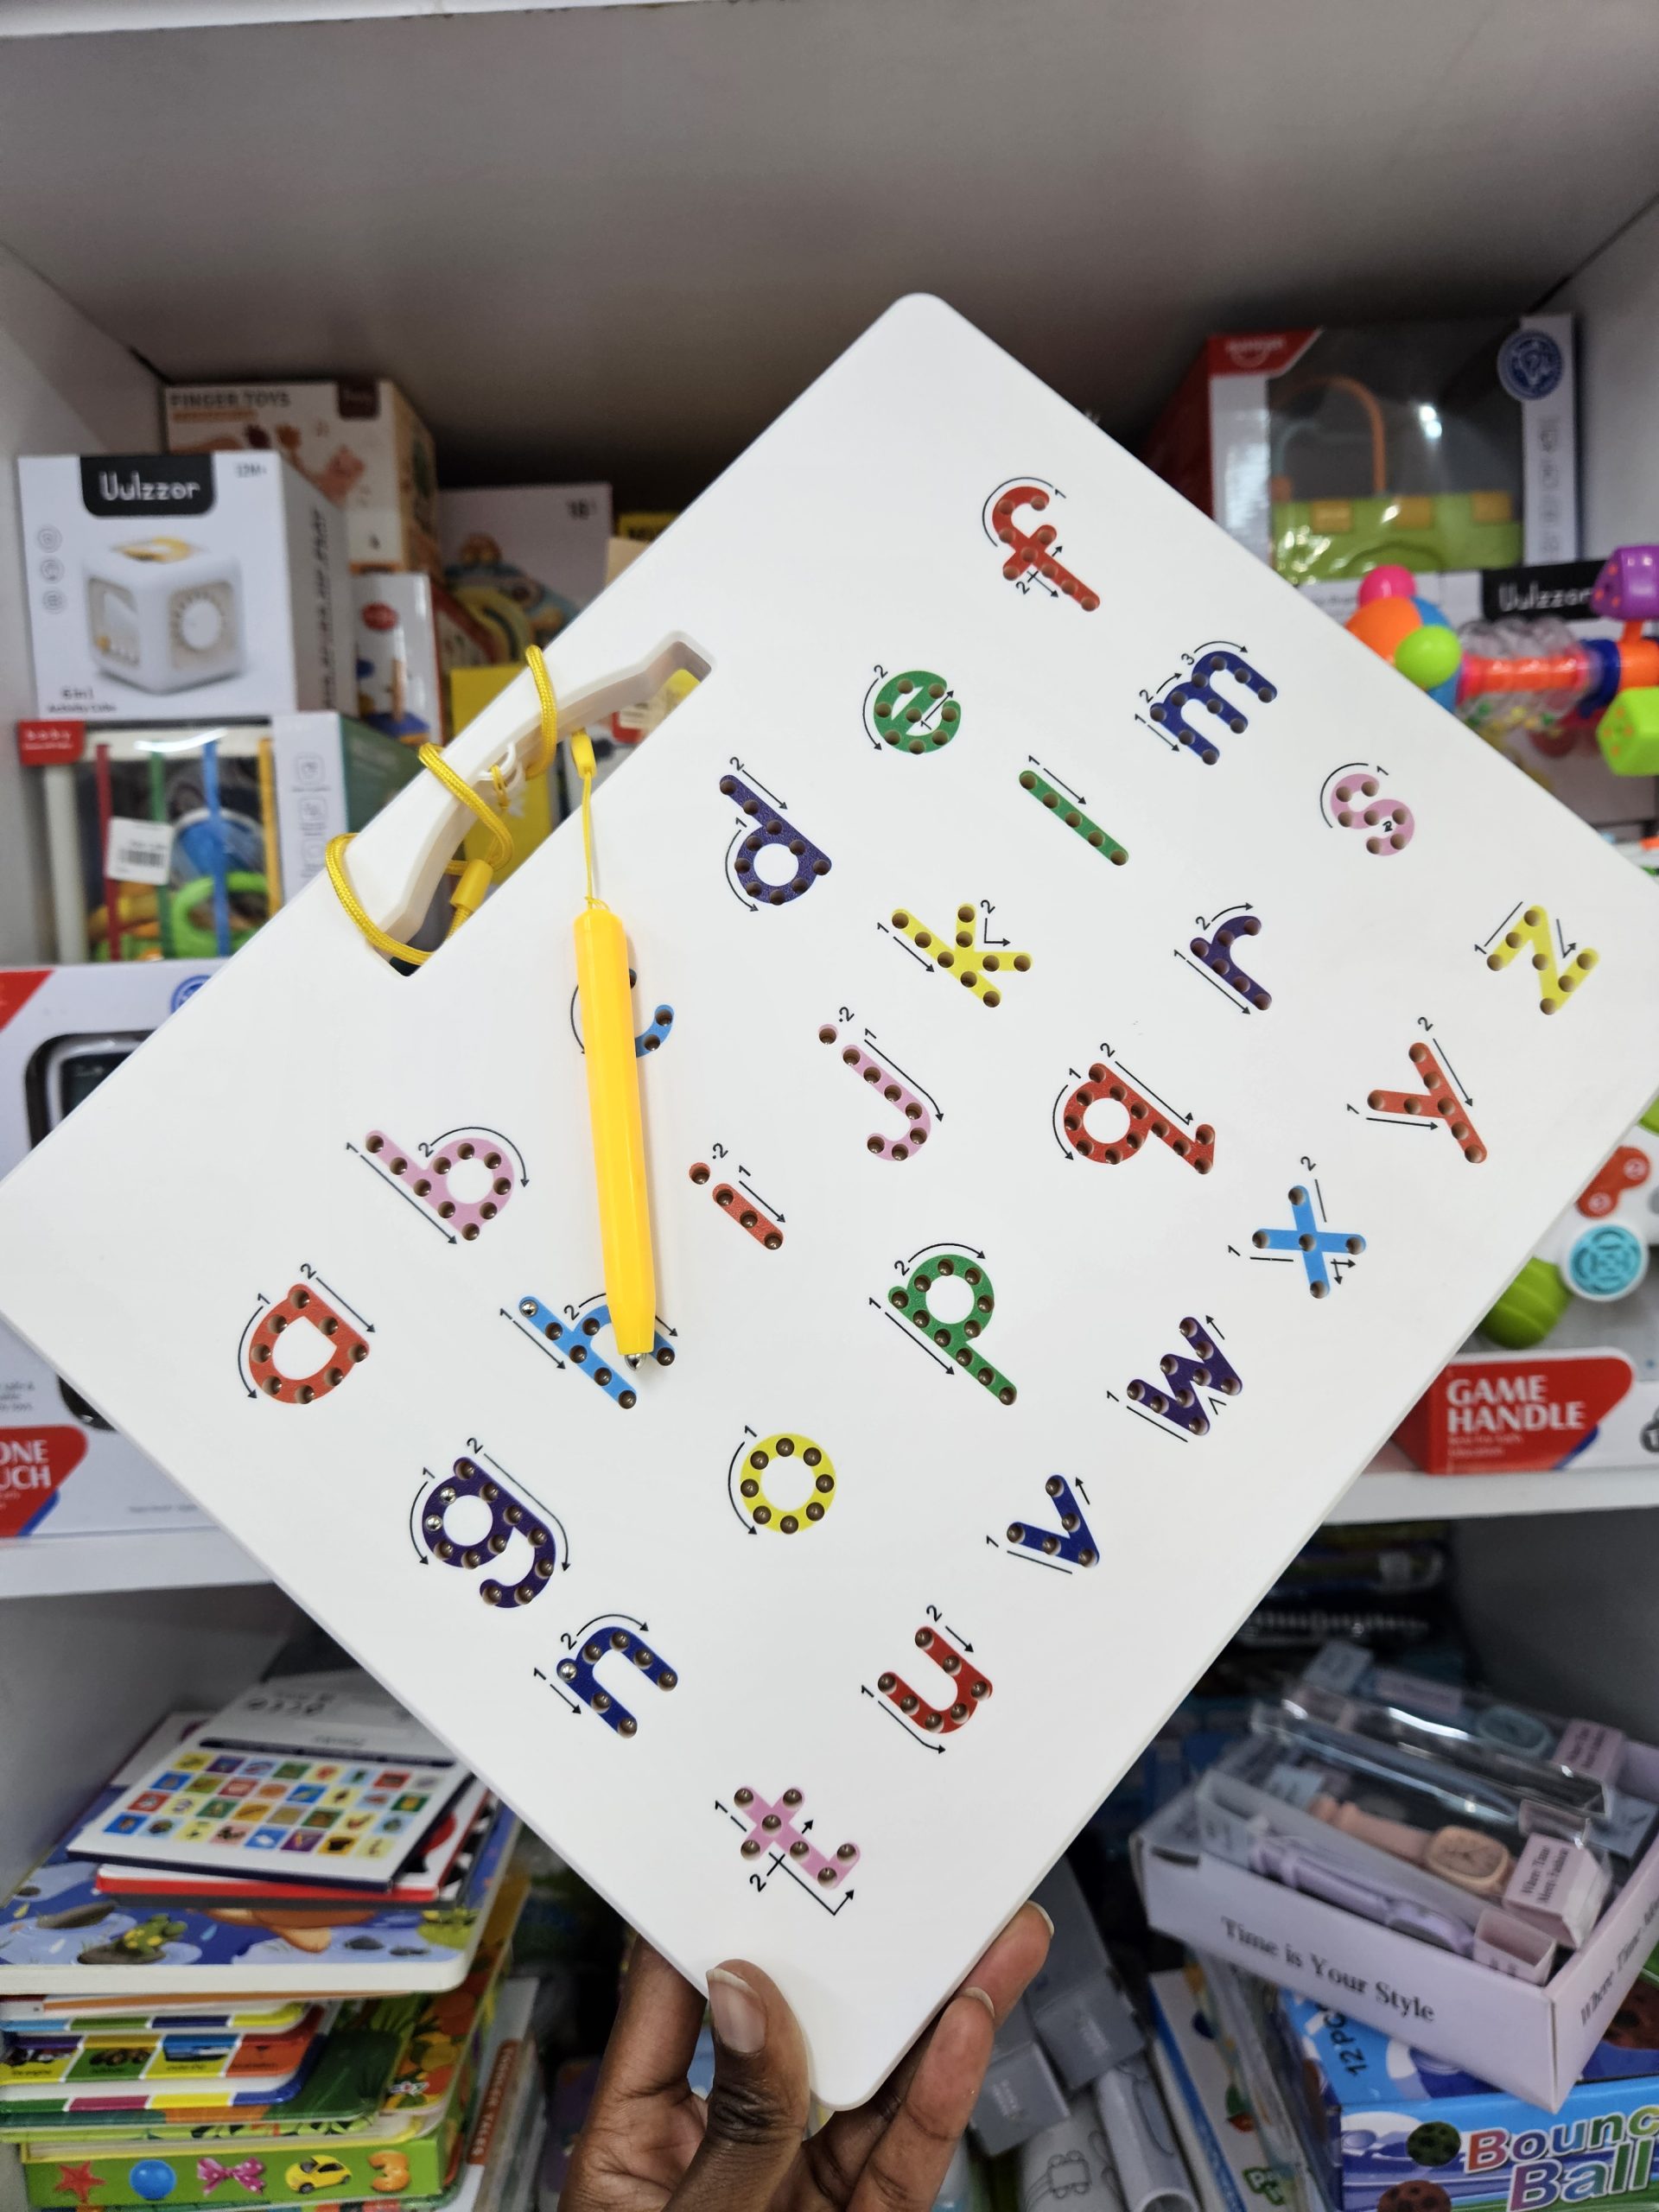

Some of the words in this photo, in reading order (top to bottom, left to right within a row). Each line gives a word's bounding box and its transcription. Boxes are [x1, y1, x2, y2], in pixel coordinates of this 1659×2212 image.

[245, 391, 291, 407] TOYS
[1054, 488, 1066, 499] 1
[992, 486, 1100, 612] f
[1015, 581, 1031, 595] 2
[1180, 652, 1195, 666] 3
[873, 664, 888, 679] 2
[1139, 689, 1154, 704] 2
[874, 671, 961, 755] e
[1150, 651, 1277, 766] m
[920, 720, 932, 731] 1
[1135, 713, 1147, 724] 1
[729, 756, 745, 772] 2
[1028, 754, 1040, 766] 1
[1376, 766, 1389, 776] 1
[735, 817, 747, 829] 1
[1331, 773, 1414, 856] s
[1382, 820, 1394, 833] 2
[720, 775, 832, 906] d
[980, 899, 996, 914] 2
[876, 922, 890, 934] 1
[1195, 916, 1211, 931] 2
[891, 904, 1032, 1008] k
[1173, 949, 1186, 961] 1
[1474, 944, 1487, 955] 1
[1190, 916, 1272, 1010] r
[1487, 905, 1599, 1015] z
[838, 1006, 855, 1022] 2
[1417, 1016, 1433, 1032] 2
[864, 1027, 877, 1039] 1
[1099, 1042, 1116, 1058] 2
[1069, 1067, 1082, 1079] 1
[818, 1023, 931, 1161] j
[1346, 1103, 1360, 1115] 1
[1366, 1042, 1487, 1163] y
[1064, 1063, 1215, 1174] q
[346, 1142, 359, 1154] 1
[417, 1141, 435, 1158] 2
[712, 1142, 729, 1159] 2
[738, 1165, 752, 1177] 1
[1300, 1155, 1317, 1172] 2
[365, 1129, 515, 1242] b
[689, 1161, 784, 1251] i
[1227, 1244, 1241, 1257] 1
[1252, 1185, 1367, 1300] x
[300, 1262, 317, 1280] 2
[893, 1260, 911, 1277] 2
[257, 1293, 270, 1305] 1
[868, 1297, 882, 1310] 1
[499, 1307, 513, 1320] 1
[563, 1304, 581, 1321] 2
[888, 1255, 1017, 1405] p
[249, 1283, 370, 1404] a
[518, 1295, 676, 1410] h
[1127, 1317, 1243, 1435] w
[1106, 1389, 1120, 1402] 1
[1446, 1376, 1548, 1407] GAME
[1447, 1402, 1586, 1433] HANDLE
[744, 1425, 758, 1438] 1
[466, 1437, 484, 1455] 2
[422, 1466, 435, 1479] 1
[740, 1433, 836, 1535] o
[1007, 1475, 1100, 1567] v
[422, 1457, 556, 1608] g
[986, 1535, 1000, 1548] 1
[925, 1605, 943, 1623] 2
[560, 1632, 578, 1651] 2
[533, 1667, 547, 1681] 1
[556, 1626, 677, 1738] n
[878, 1626, 993, 1733] u
[861, 1684, 875, 1699] 1
[714, 1800, 728, 1814] 1
[734, 1787, 860, 1886] t
[749, 1873, 767, 1893] 2
[1220, 1915, 1279, 1956] Time
[1286, 1943, 1303, 1967] is
[1311, 1952, 1369, 1994] Your
[1375, 1981, 1435, 2023] Style
[1506, 2138, 1653, 2212] Ball
